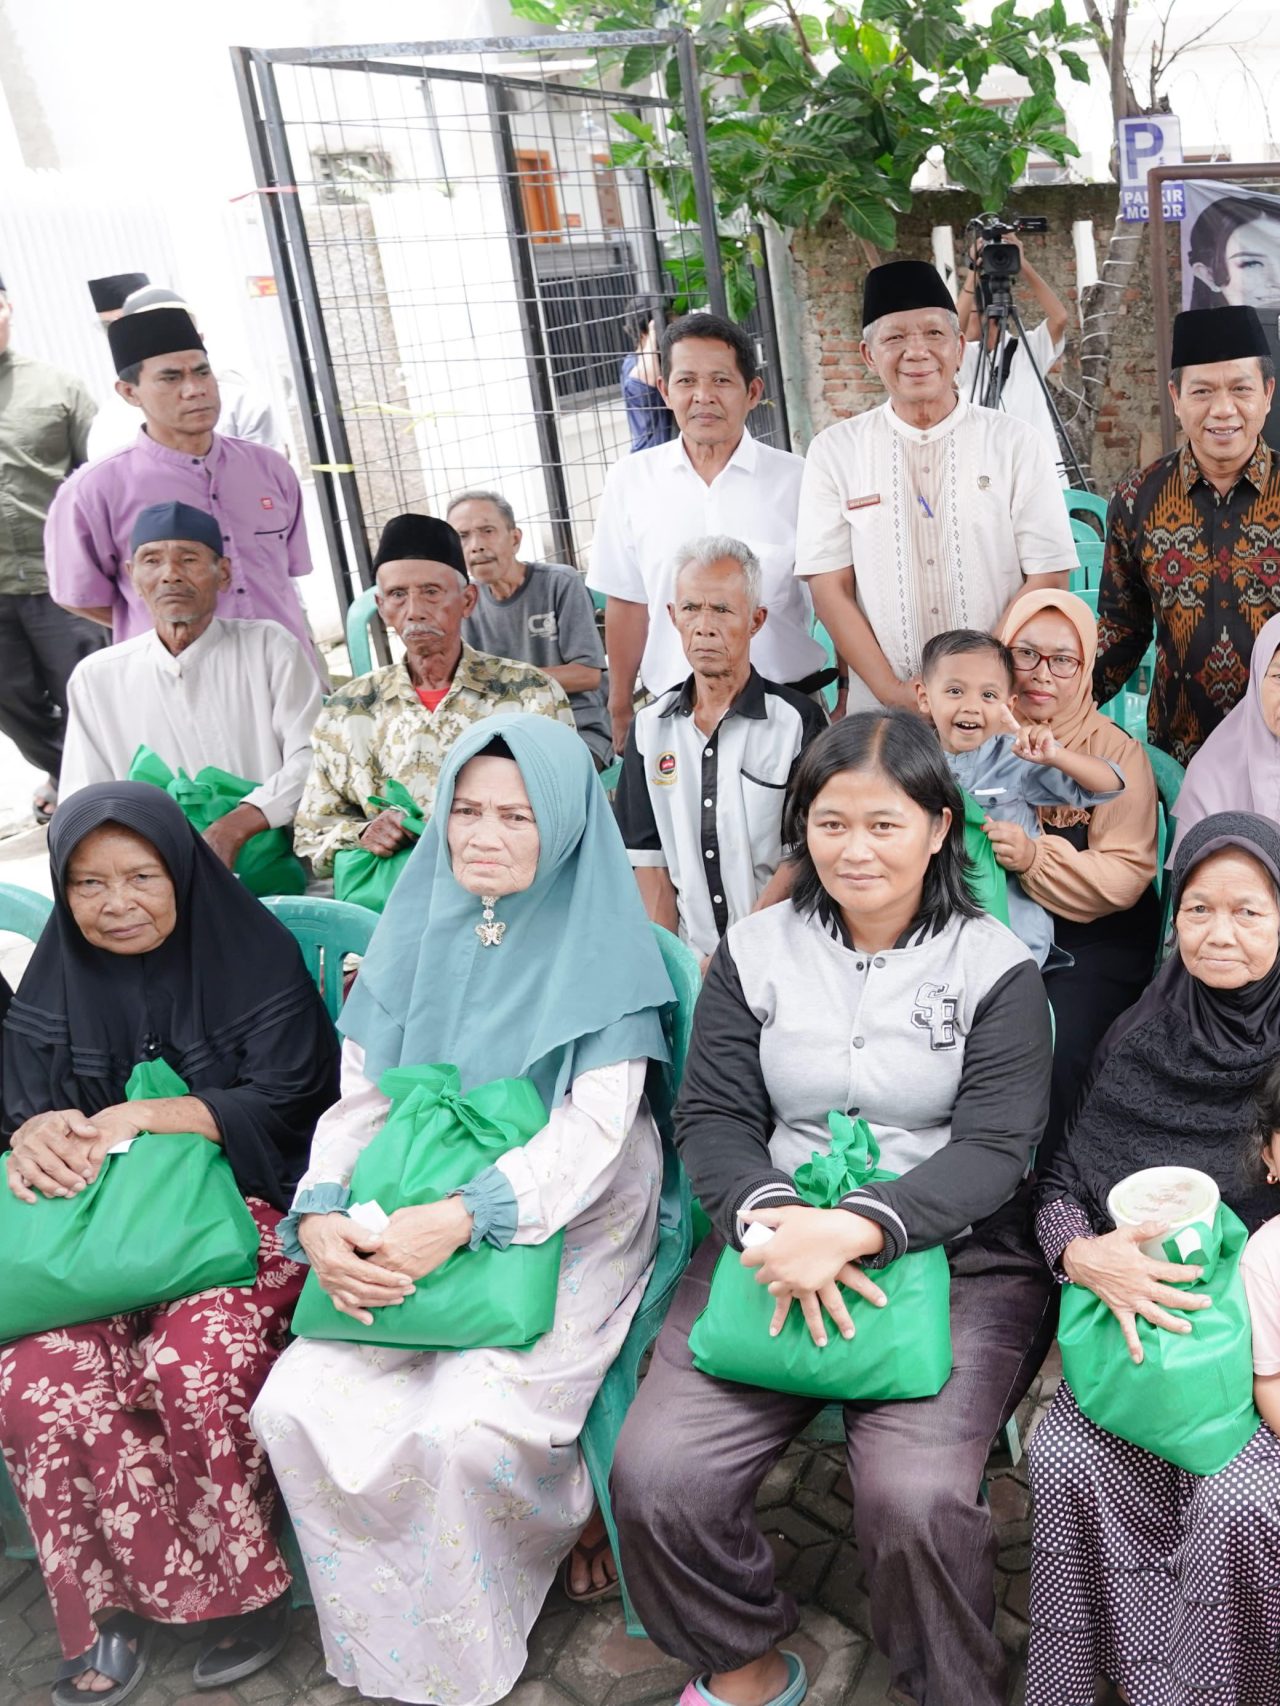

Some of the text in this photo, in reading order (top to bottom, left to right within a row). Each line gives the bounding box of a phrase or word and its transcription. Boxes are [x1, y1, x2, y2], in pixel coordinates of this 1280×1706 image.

[1124, 123, 1164, 180] P
[1124, 189, 1183, 204] PAIR
[1126, 204, 1184, 219] MOOR
